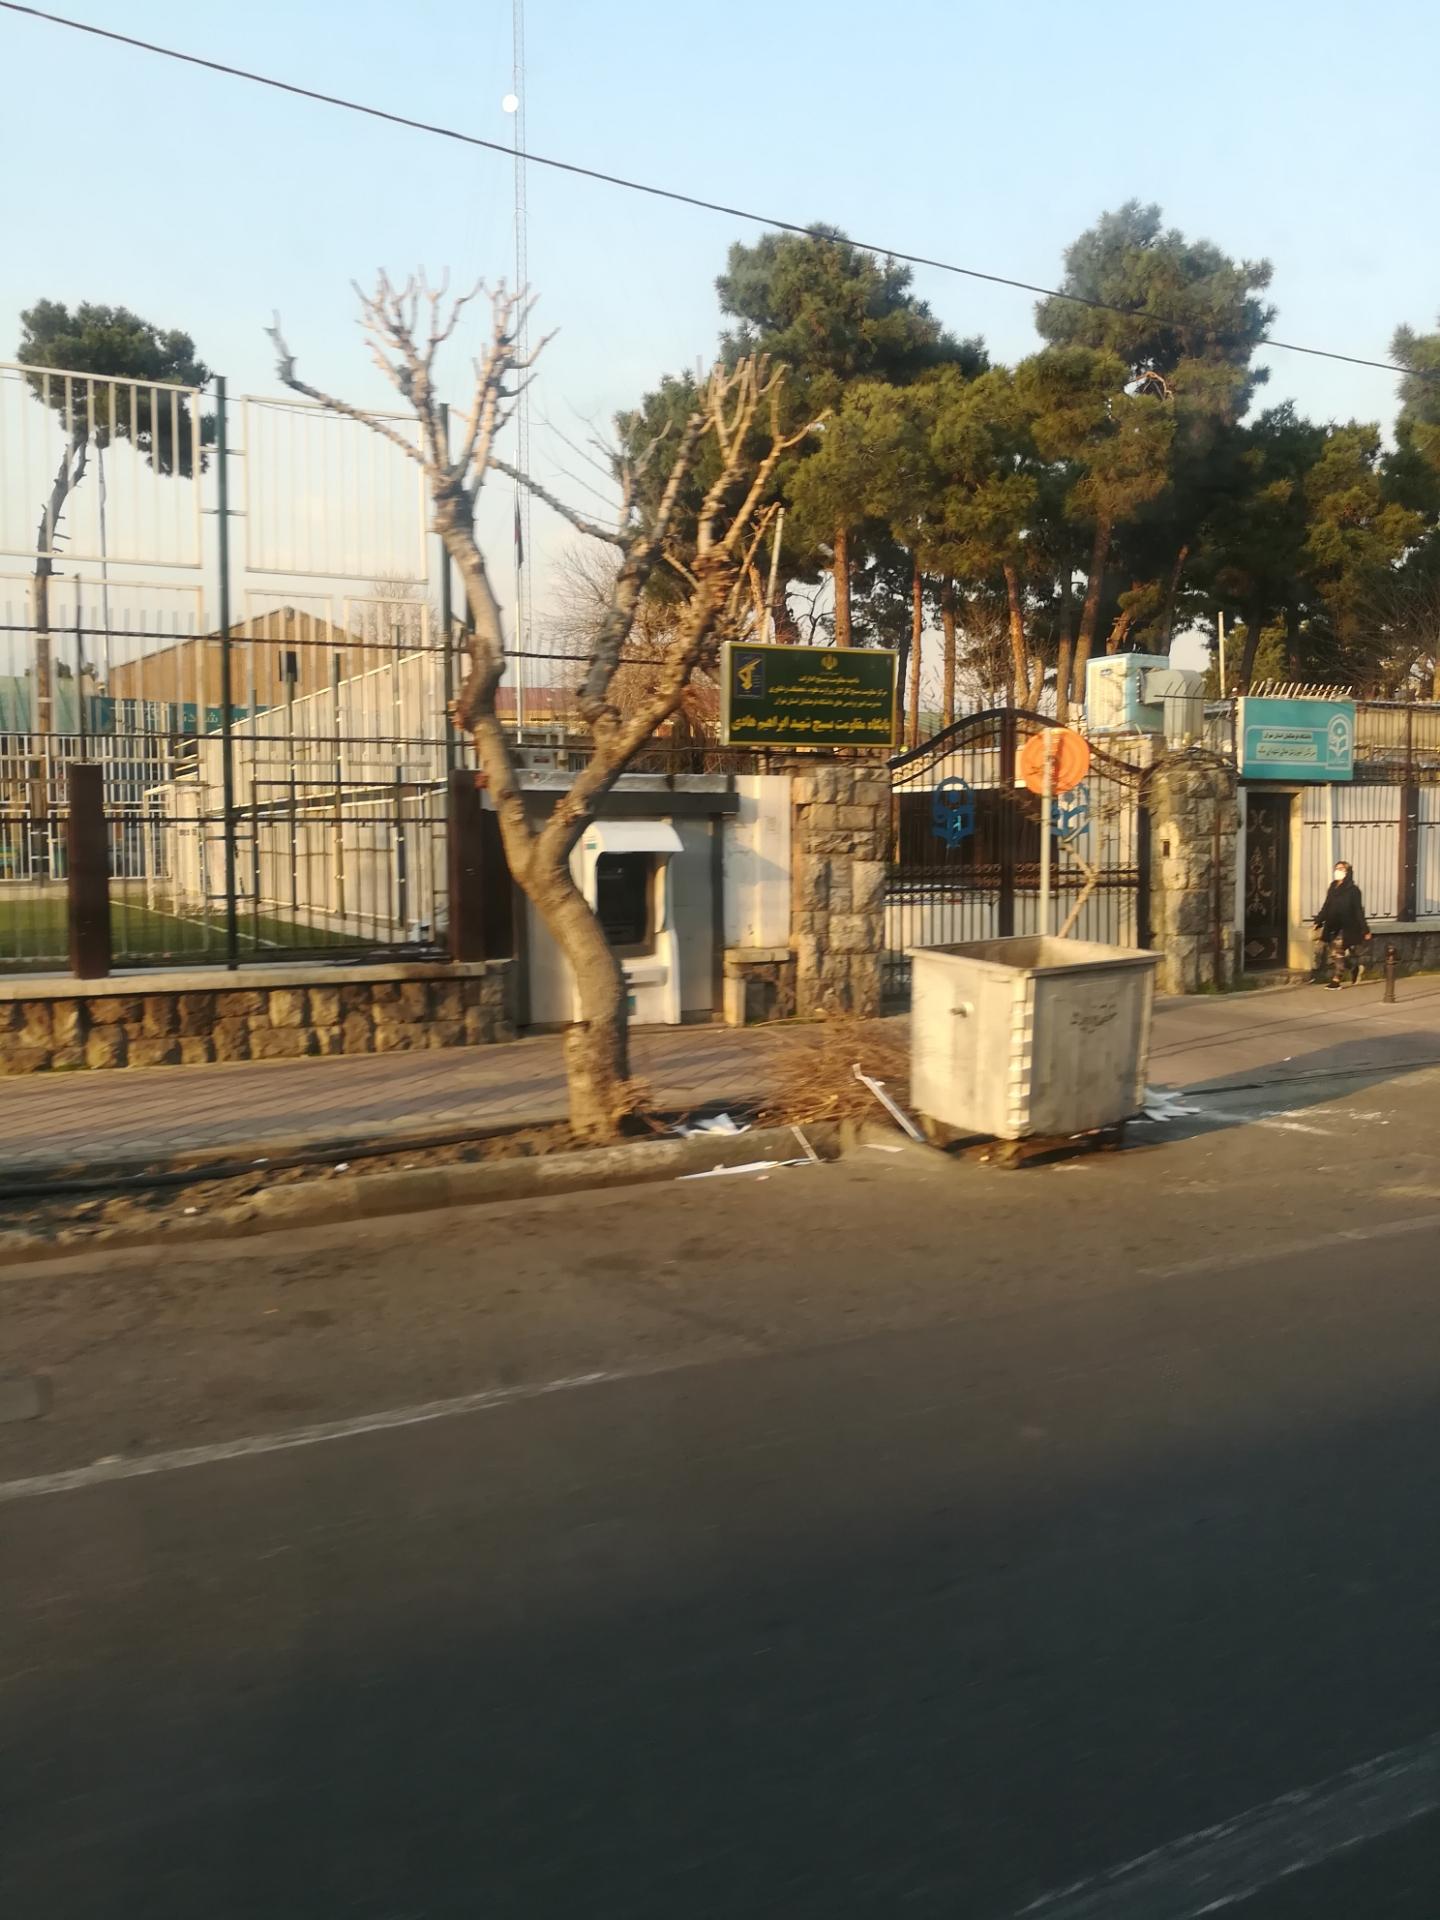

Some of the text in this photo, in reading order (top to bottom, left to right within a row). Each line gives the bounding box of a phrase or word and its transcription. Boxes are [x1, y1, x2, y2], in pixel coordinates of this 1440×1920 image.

[730, 714, 890, 734] پایگاه مقاومت بسیج شهید ابراهیم هادی
